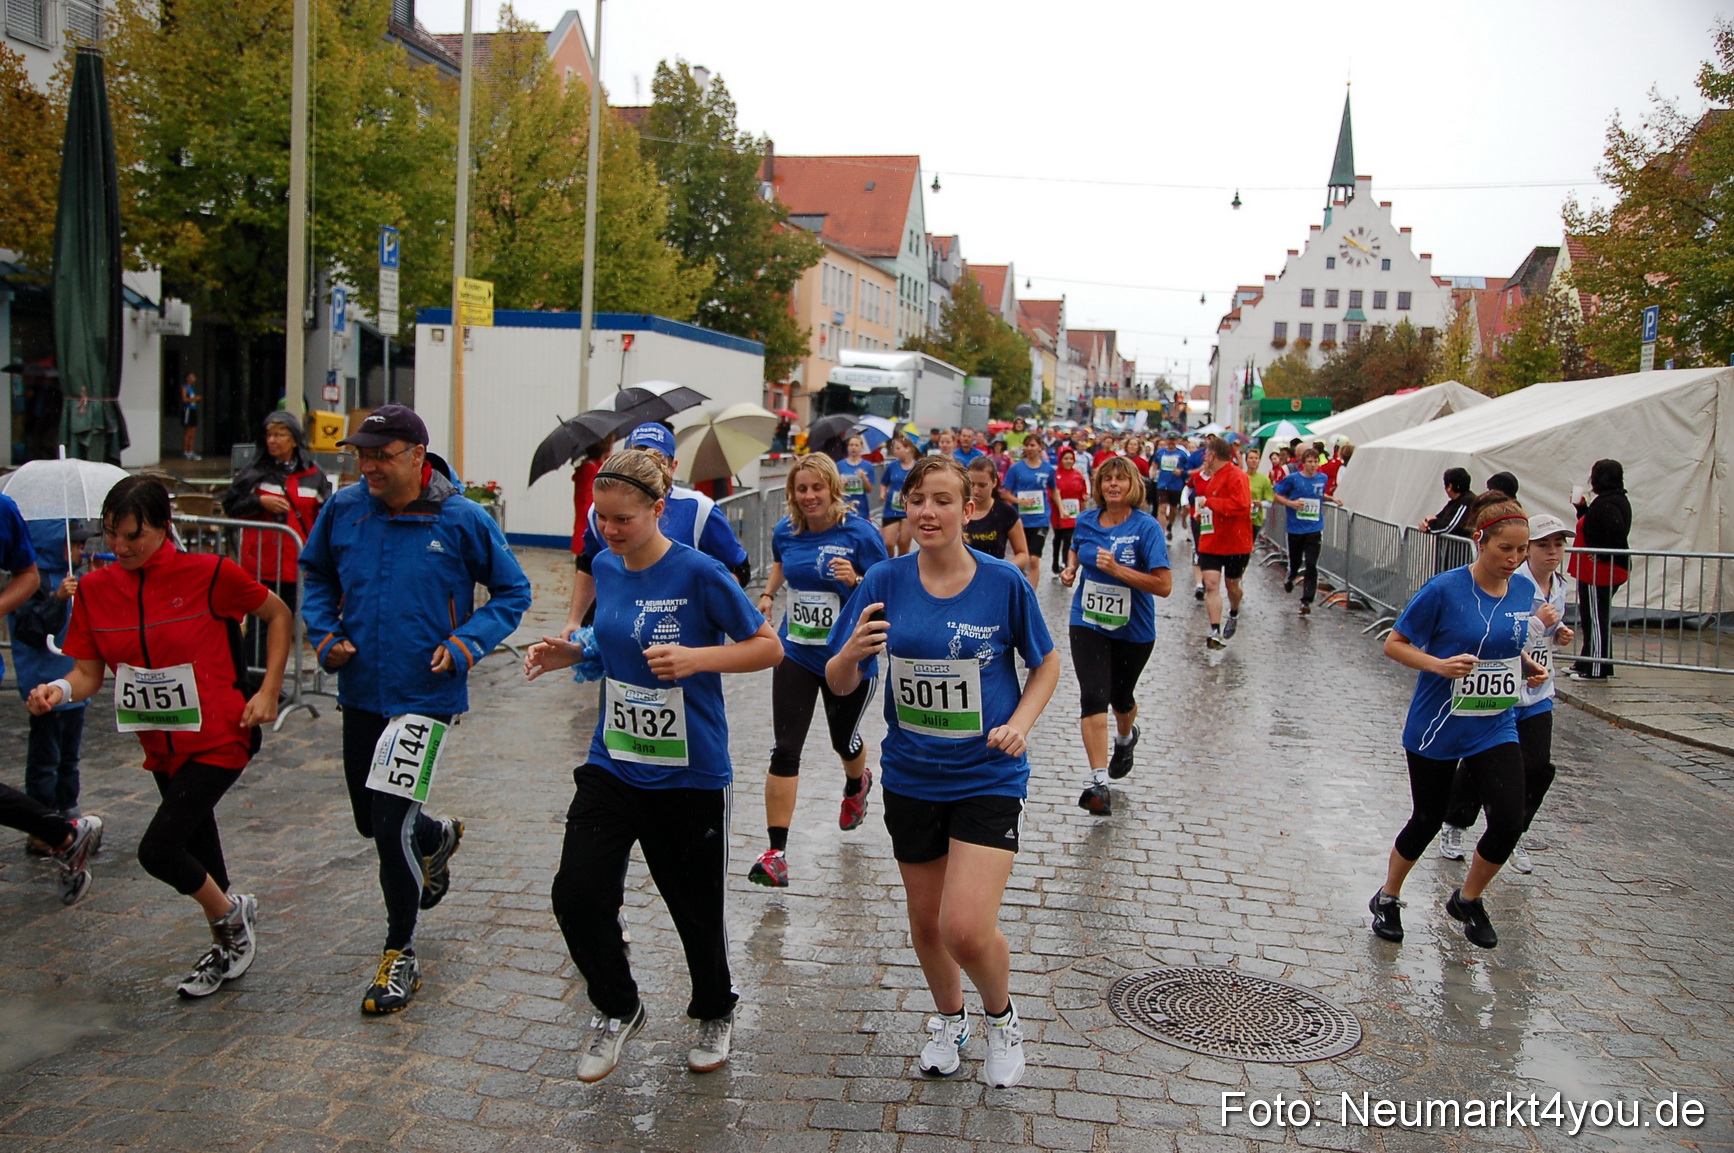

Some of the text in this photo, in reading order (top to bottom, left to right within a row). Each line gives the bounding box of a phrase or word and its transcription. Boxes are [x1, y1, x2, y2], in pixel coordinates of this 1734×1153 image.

[334, 293, 342, 326] P
[1645, 311, 1655, 338] P
[793, 602, 833, 627] 5048
[1086, 593, 1124, 614] 5121
[946, 621, 1000, 633] 12. NEUMARKTER
[955, 628, 993, 640] STADTLAUF
[913, 664, 950, 673] BOCK
[899, 677, 969, 709] 5011
[1461, 673, 1516, 696] 5056
[122, 682, 187, 710] 5151
[1475, 700, 1497, 709] Julia
[137, 713, 179, 723] Carmen
[613, 701, 677, 738] 5132
[921, 714, 949, 727] Julia
[388, 723, 429, 789] 5144
[632, 740, 656, 754] Jana
